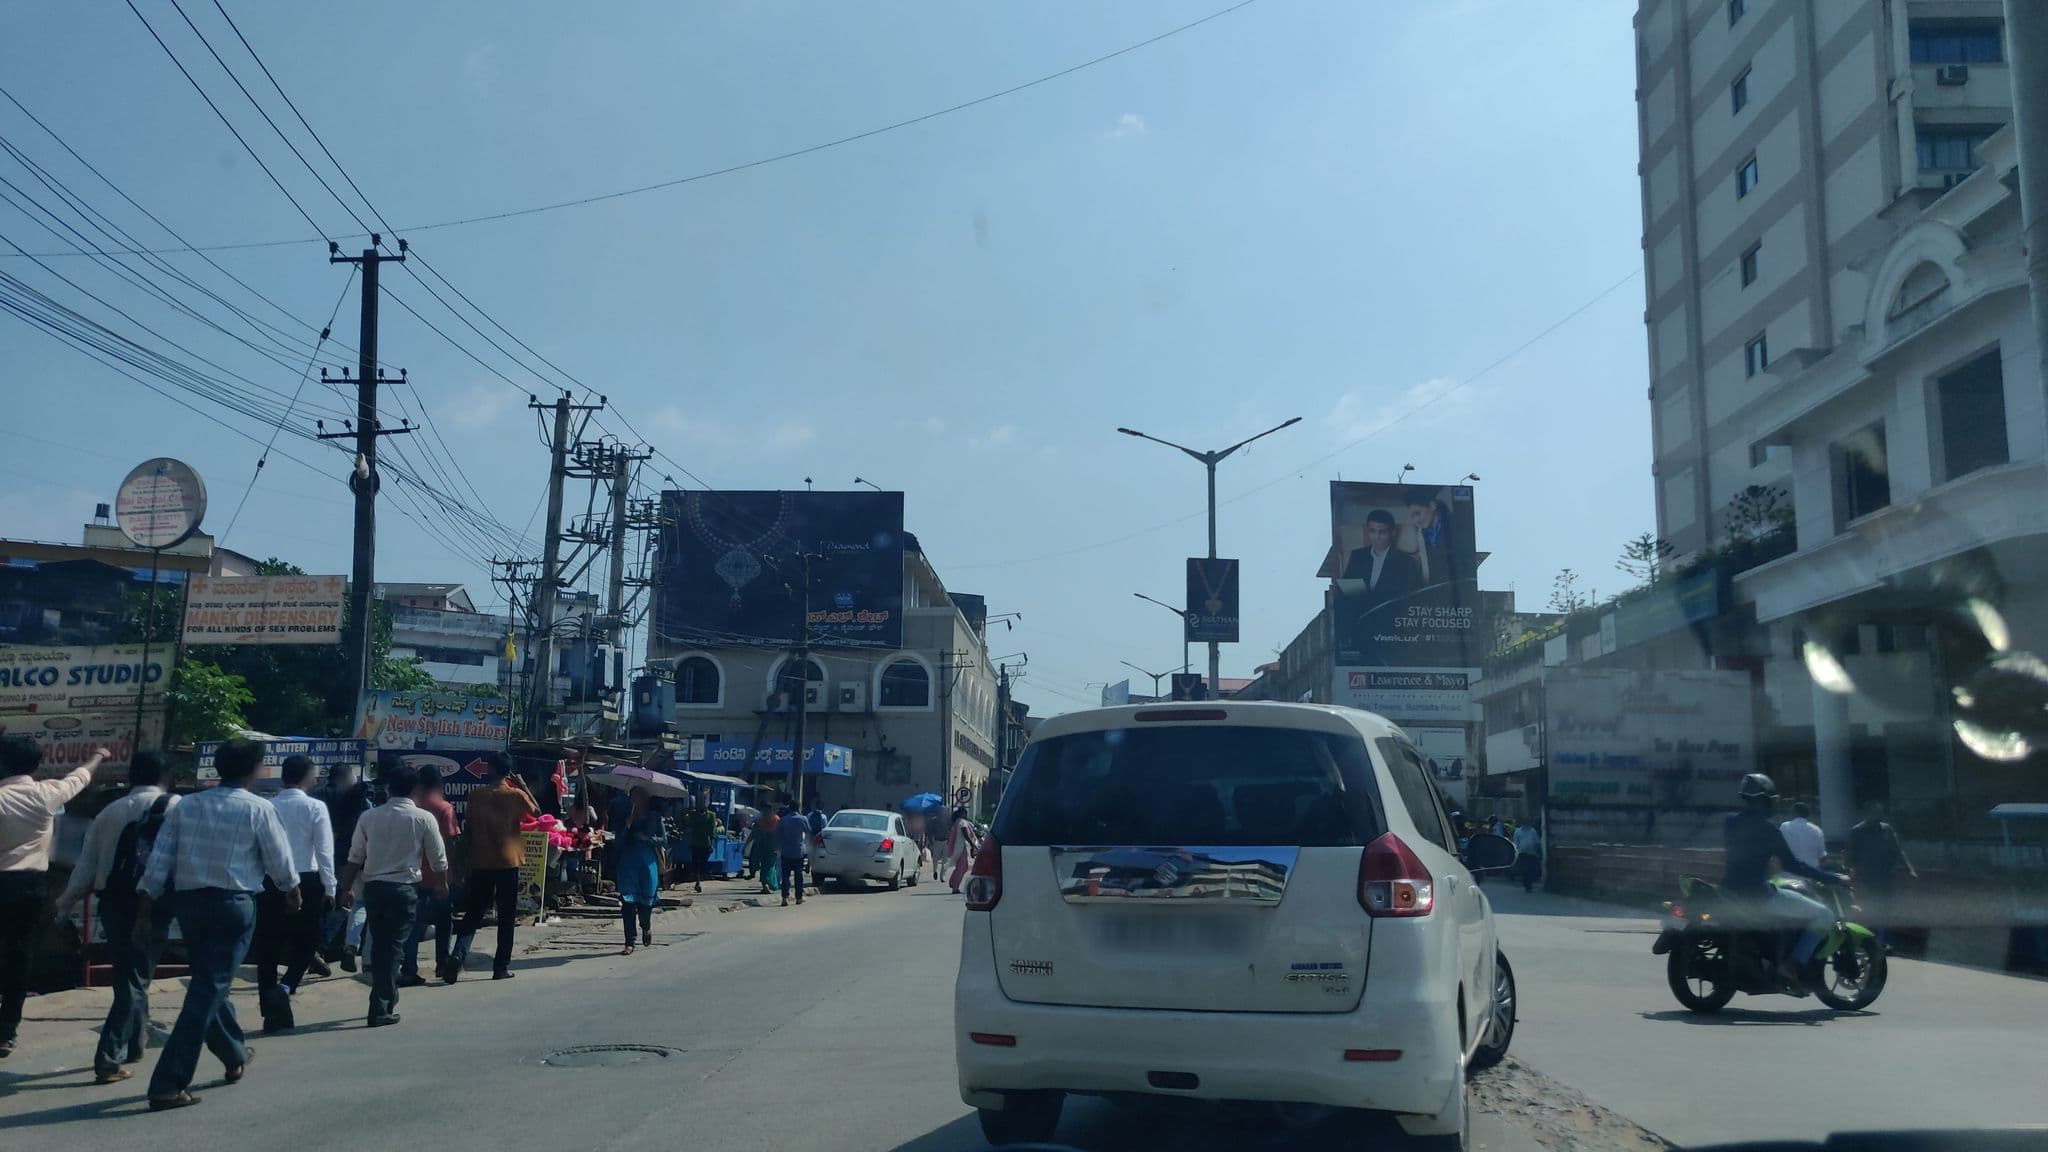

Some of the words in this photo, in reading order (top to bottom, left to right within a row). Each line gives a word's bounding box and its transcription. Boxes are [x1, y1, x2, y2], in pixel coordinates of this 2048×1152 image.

[188, 611, 240, 625] MANEK
[244, 609, 337, 625] DISPENSARY
[1408, 606, 1433, 617] STAY
[1434, 607, 1472, 618] SHARP
[187, 625, 204, 633] FOR
[207, 625, 222, 633] ALL
[225, 625, 252, 633] KINDS
[254, 625, 266, 633] OF
[287, 624, 336, 633] PROBLEMS
[1394, 617, 1420, 627] STAY
[1422, 618, 1471, 629] FOCUSED
[67, 662, 162, 686] STUDIO
[1370, 674, 1422, 687] Lawrence
[1424, 675, 1433, 686] &
[386, 715, 417, 731] New
[418, 716, 461, 737] Stylish
[463, 719, 507, 738] Tailors
[276, 743, 308, 752] BATTERY
[316, 742, 337, 752] HARD
[1008, 966, 1053, 977] SUZUKI
[1283, 973, 1349, 984] ERTIGA
